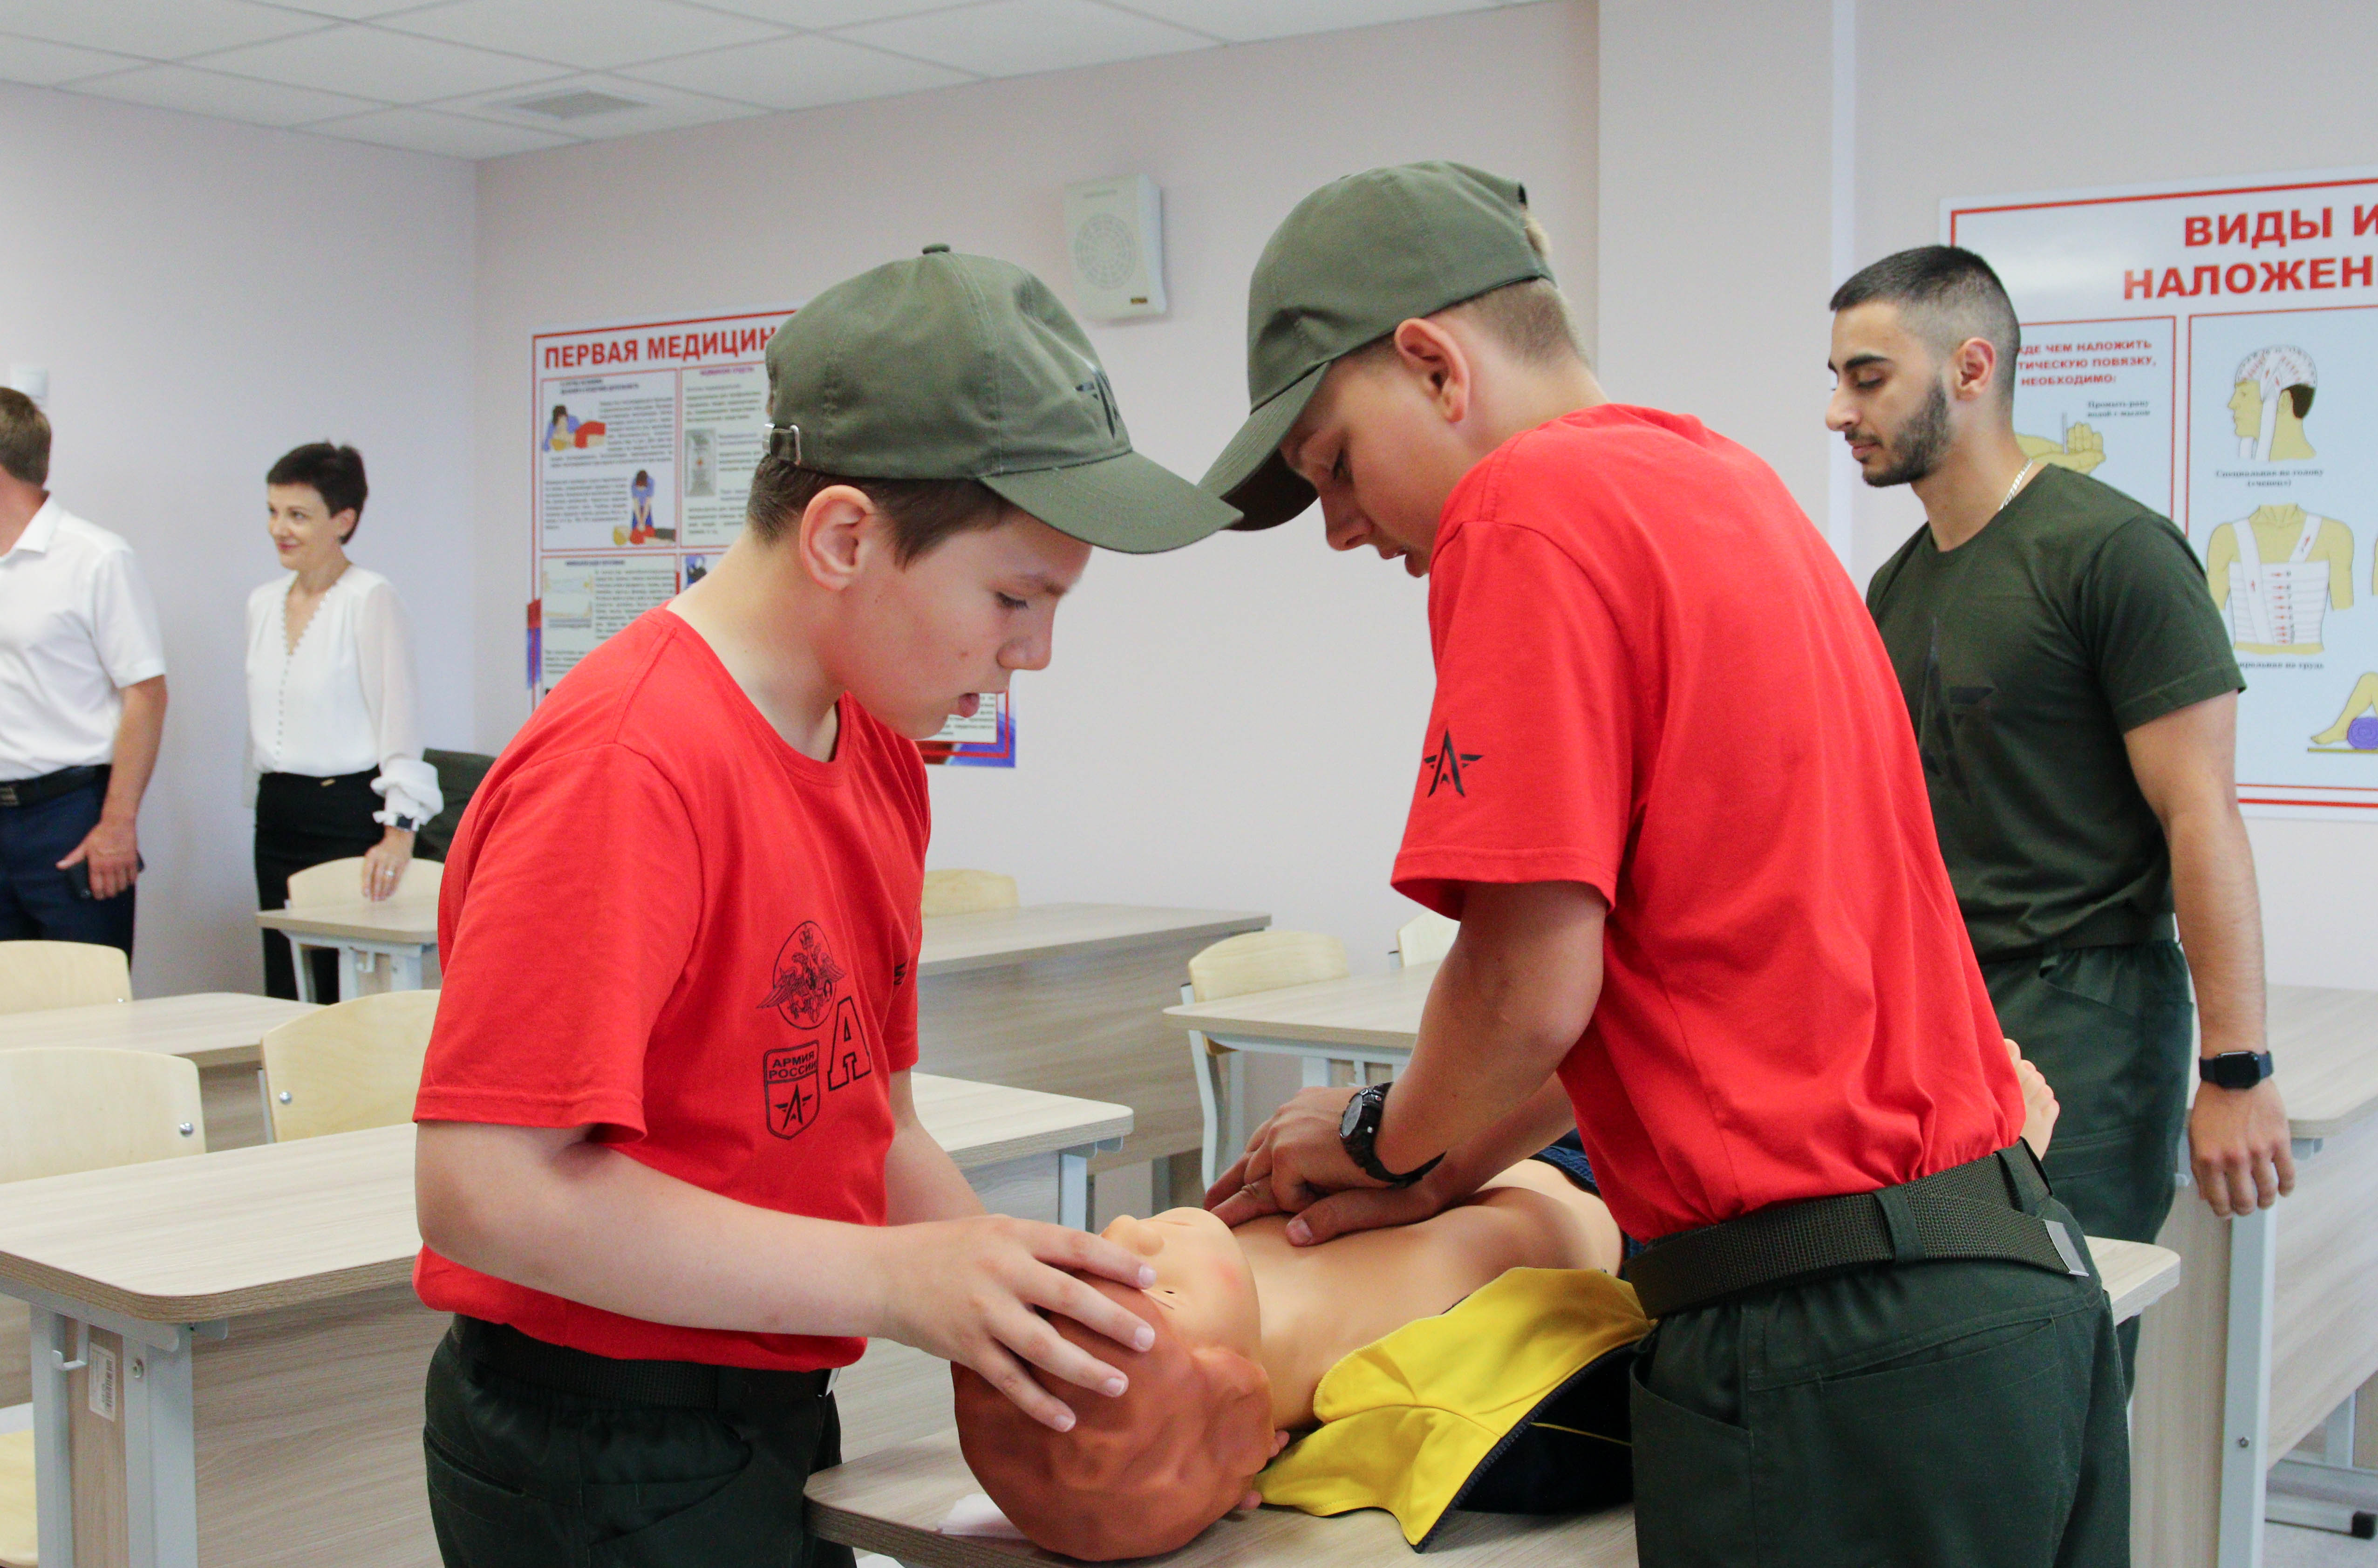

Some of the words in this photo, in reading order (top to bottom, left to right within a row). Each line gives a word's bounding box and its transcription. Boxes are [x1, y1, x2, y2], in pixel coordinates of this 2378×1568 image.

[2185, 206, 2332, 250] ВИДЫ
[2353, 204, 2378, 236] И
[2124, 255, 2373, 300] НАЛОЖЕН
[545, 339, 638, 369] ПЕРВАЯ
[647, 325, 777, 361] МЕДИЦИН
[2046, 343, 2072, 353] ЧЕМ
[2077, 340, 2152, 351] НАЛОЖИТЬ
[2017, 359, 2088, 370] ТИЧЕСКУЮ
[2092, 355, 2156, 368] ПОВЯЗКУ,
[2021, 374, 2116, 386] НЕОБХОДИМО:
[772, 1050, 814, 1069] АРМИЯ
[769, 1061, 817, 1079] РОССИИ
